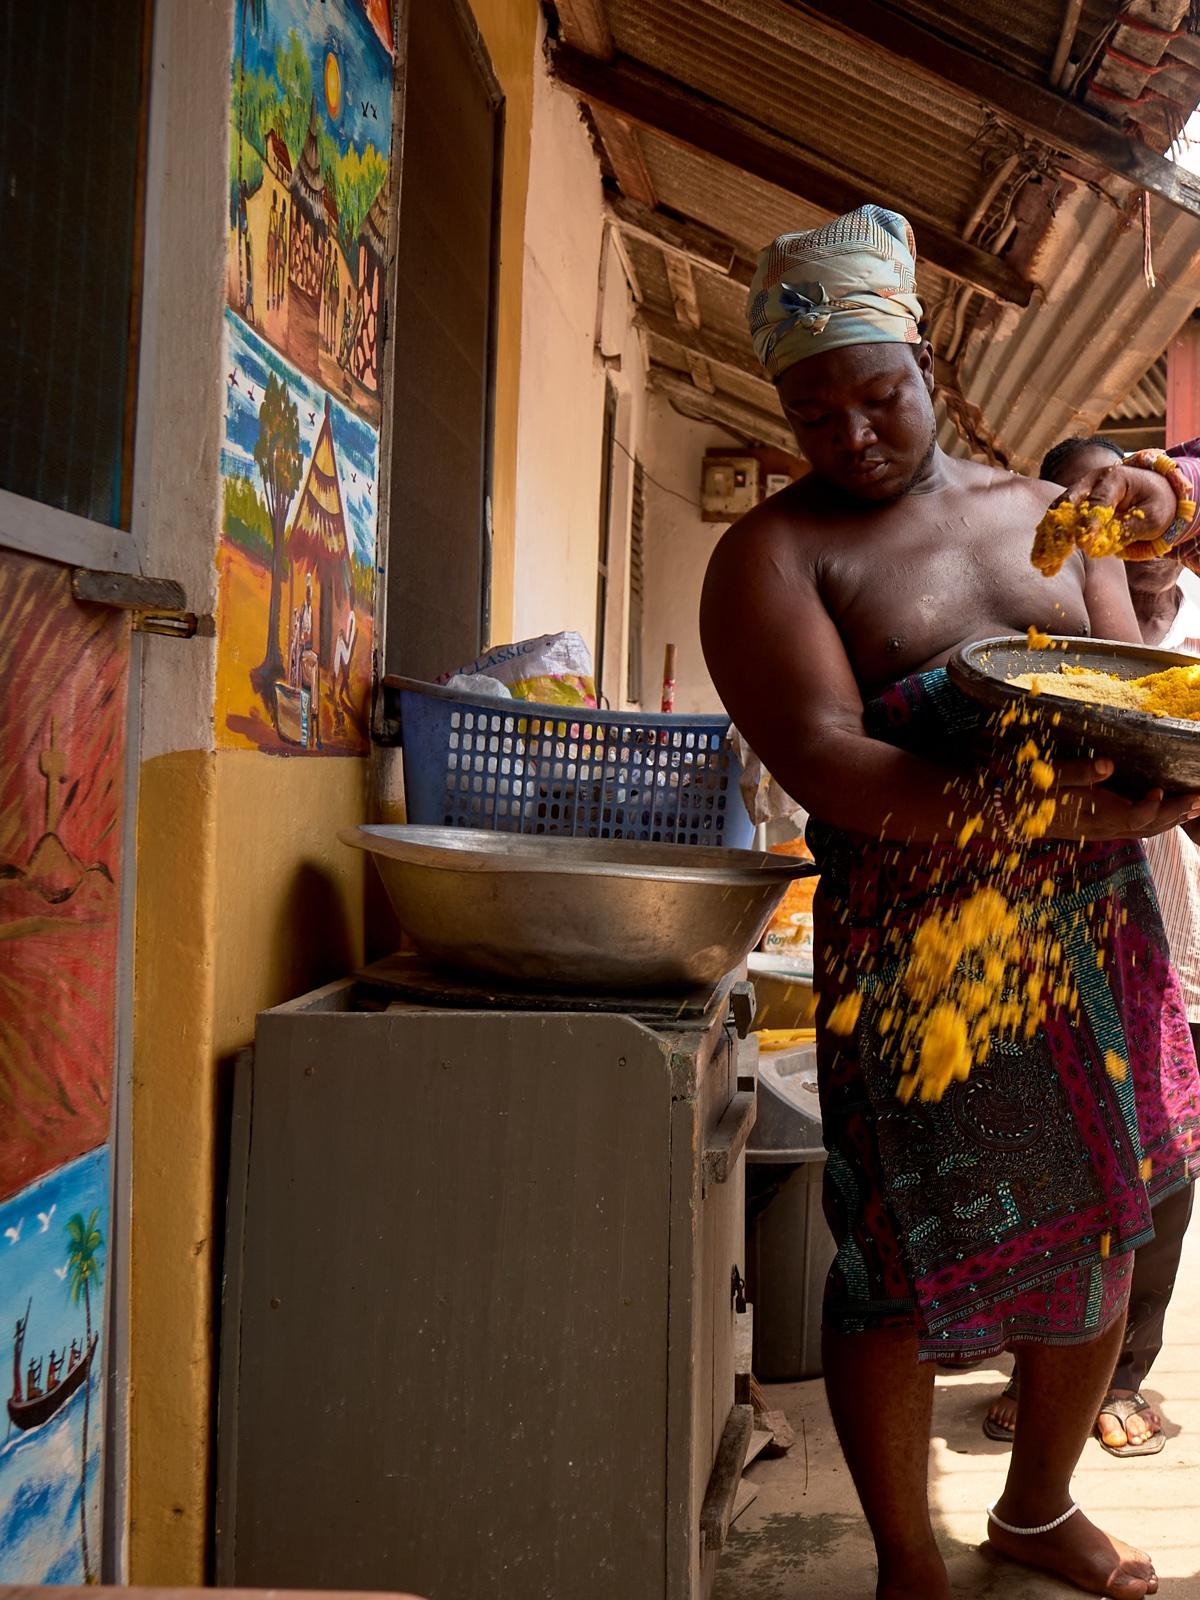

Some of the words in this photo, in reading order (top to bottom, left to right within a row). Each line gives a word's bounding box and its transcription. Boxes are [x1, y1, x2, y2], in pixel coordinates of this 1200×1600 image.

[458, 641, 535, 675] CLASSIC
[931, 1307, 974, 1331] GUARANTEED
[975, 1299, 990, 1311] WAX
[993, 1289, 1015, 1303] BLOCK
[1017, 1277, 1040, 1291] PRINTS
